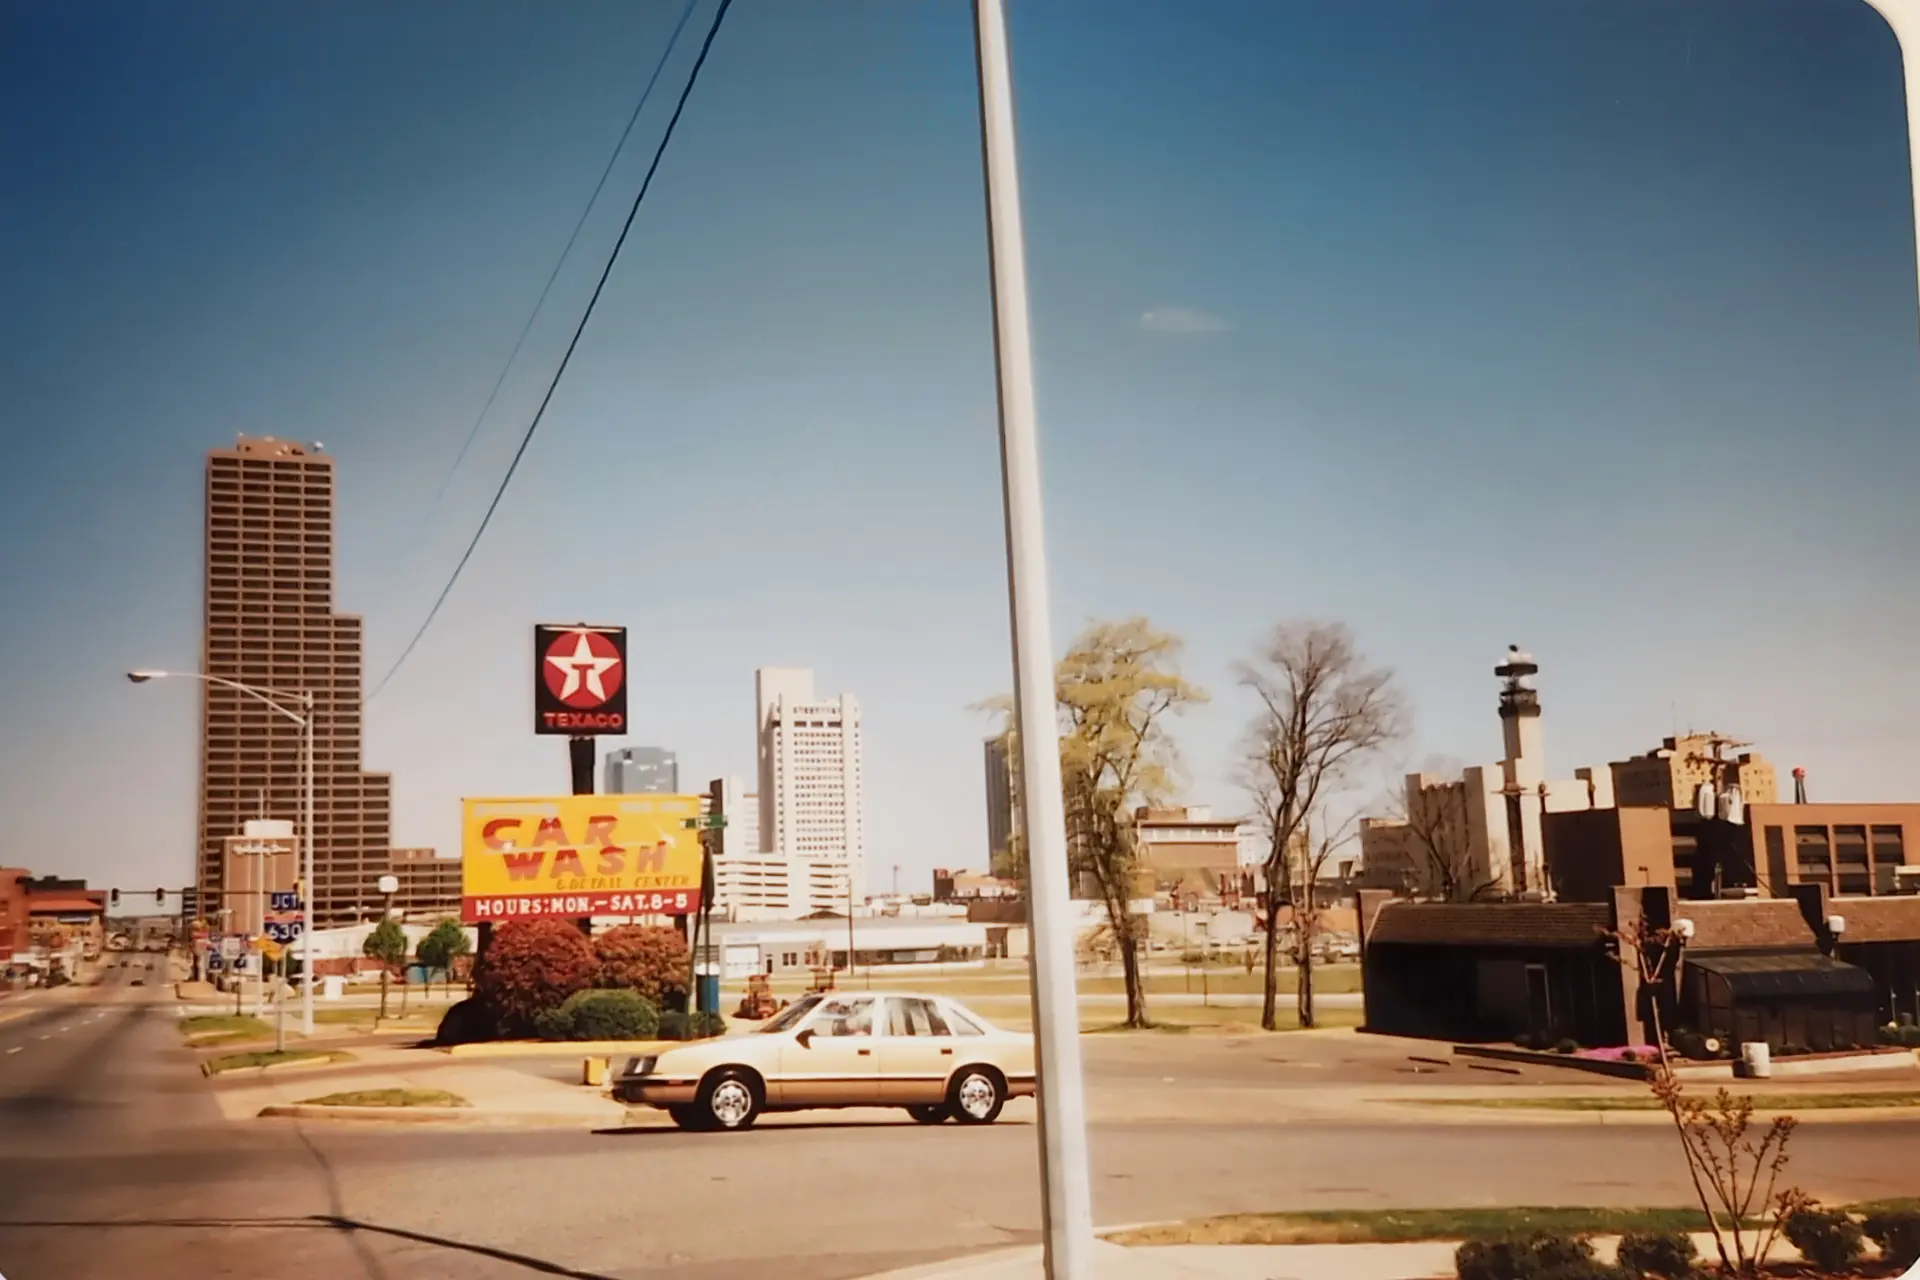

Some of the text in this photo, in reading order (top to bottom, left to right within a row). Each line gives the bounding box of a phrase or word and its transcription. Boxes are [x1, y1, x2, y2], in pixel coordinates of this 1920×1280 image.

[543, 712, 622, 728] TEXACO
[482, 814, 619, 850] CAR
[502, 840, 668, 881] WASH
[634, 875, 690, 888] CENTER
[272, 895, 298, 908] JCT
[269, 924, 301, 939] 630
